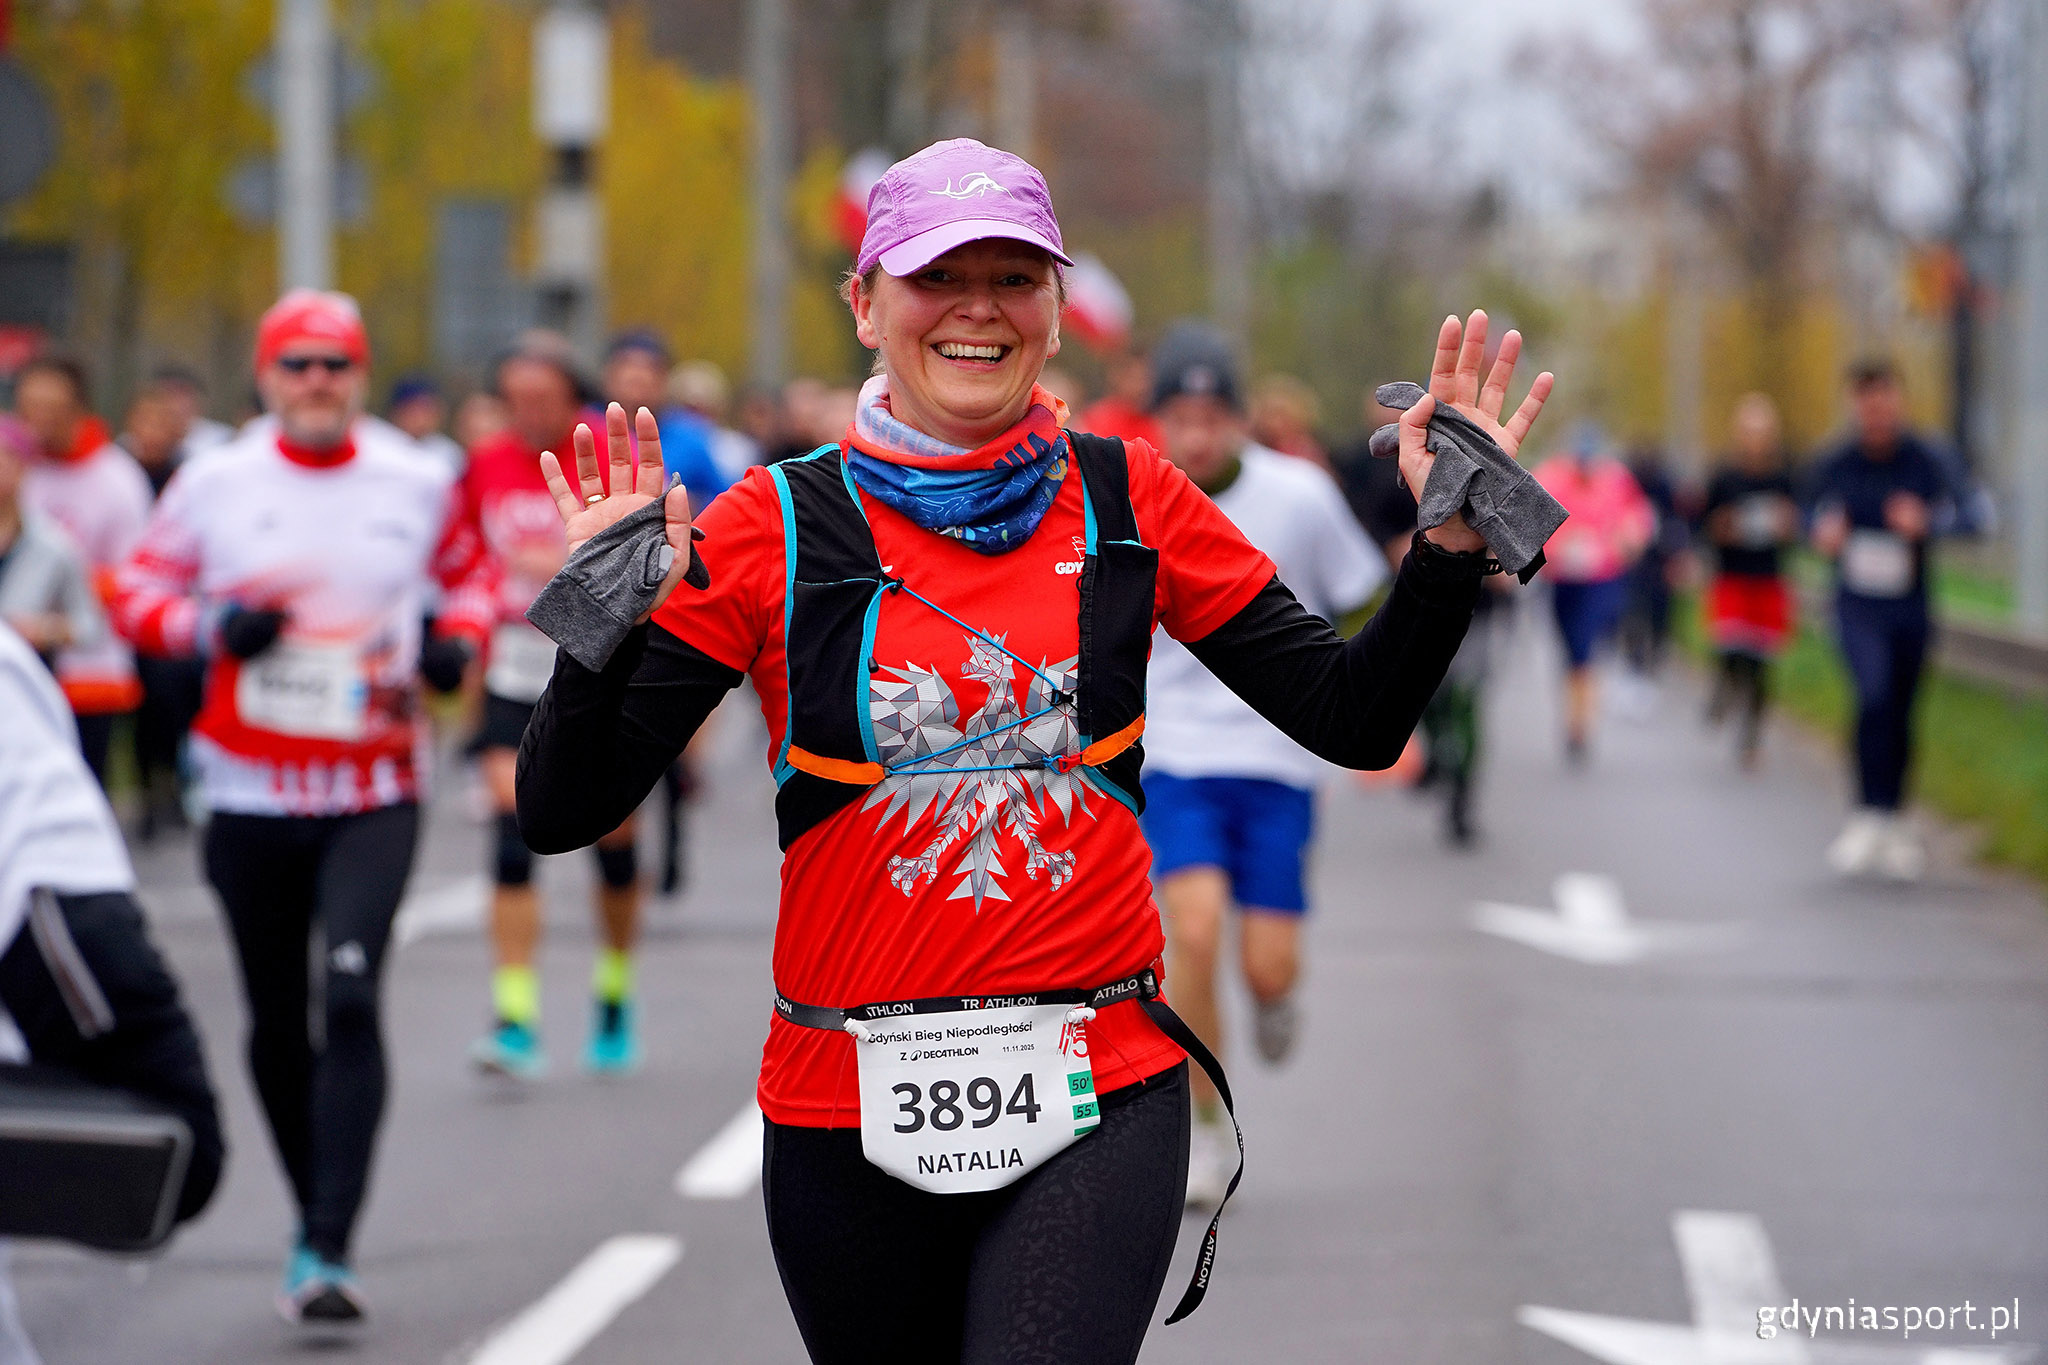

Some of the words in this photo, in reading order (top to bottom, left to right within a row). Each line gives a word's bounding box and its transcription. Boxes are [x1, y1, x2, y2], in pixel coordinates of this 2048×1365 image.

[915, 1029, 943, 1042] Bieg
[946, 1021, 1033, 1040] Niepodległości
[923, 1047, 979, 1060] DECATHLON
[1002, 1044, 1035, 1053] 11.11.2025
[891, 1072, 1042, 1134] 3894
[917, 1148, 1025, 1175] NATALIA
